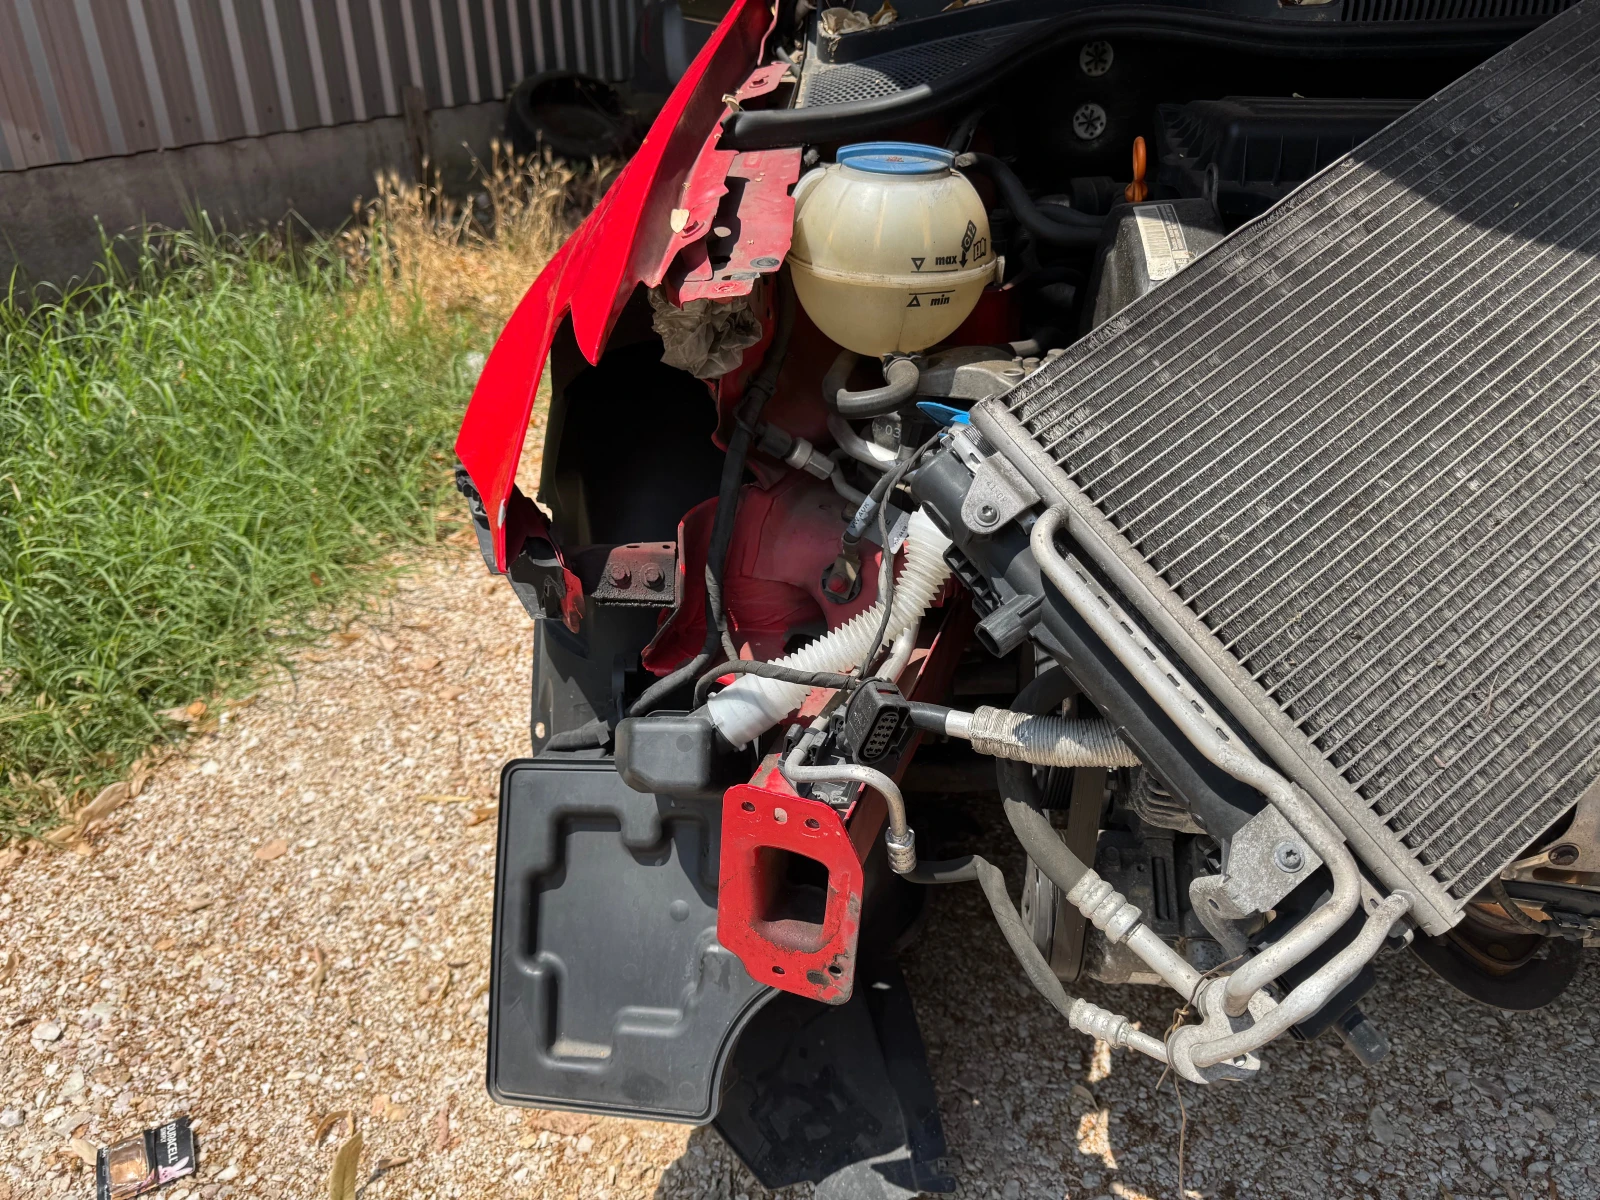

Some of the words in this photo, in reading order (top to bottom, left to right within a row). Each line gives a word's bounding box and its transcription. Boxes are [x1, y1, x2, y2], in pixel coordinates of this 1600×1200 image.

[935, 255, 957, 266] max
[930, 294, 950, 306] min
[166, 1123, 178, 1164] DURACELL
